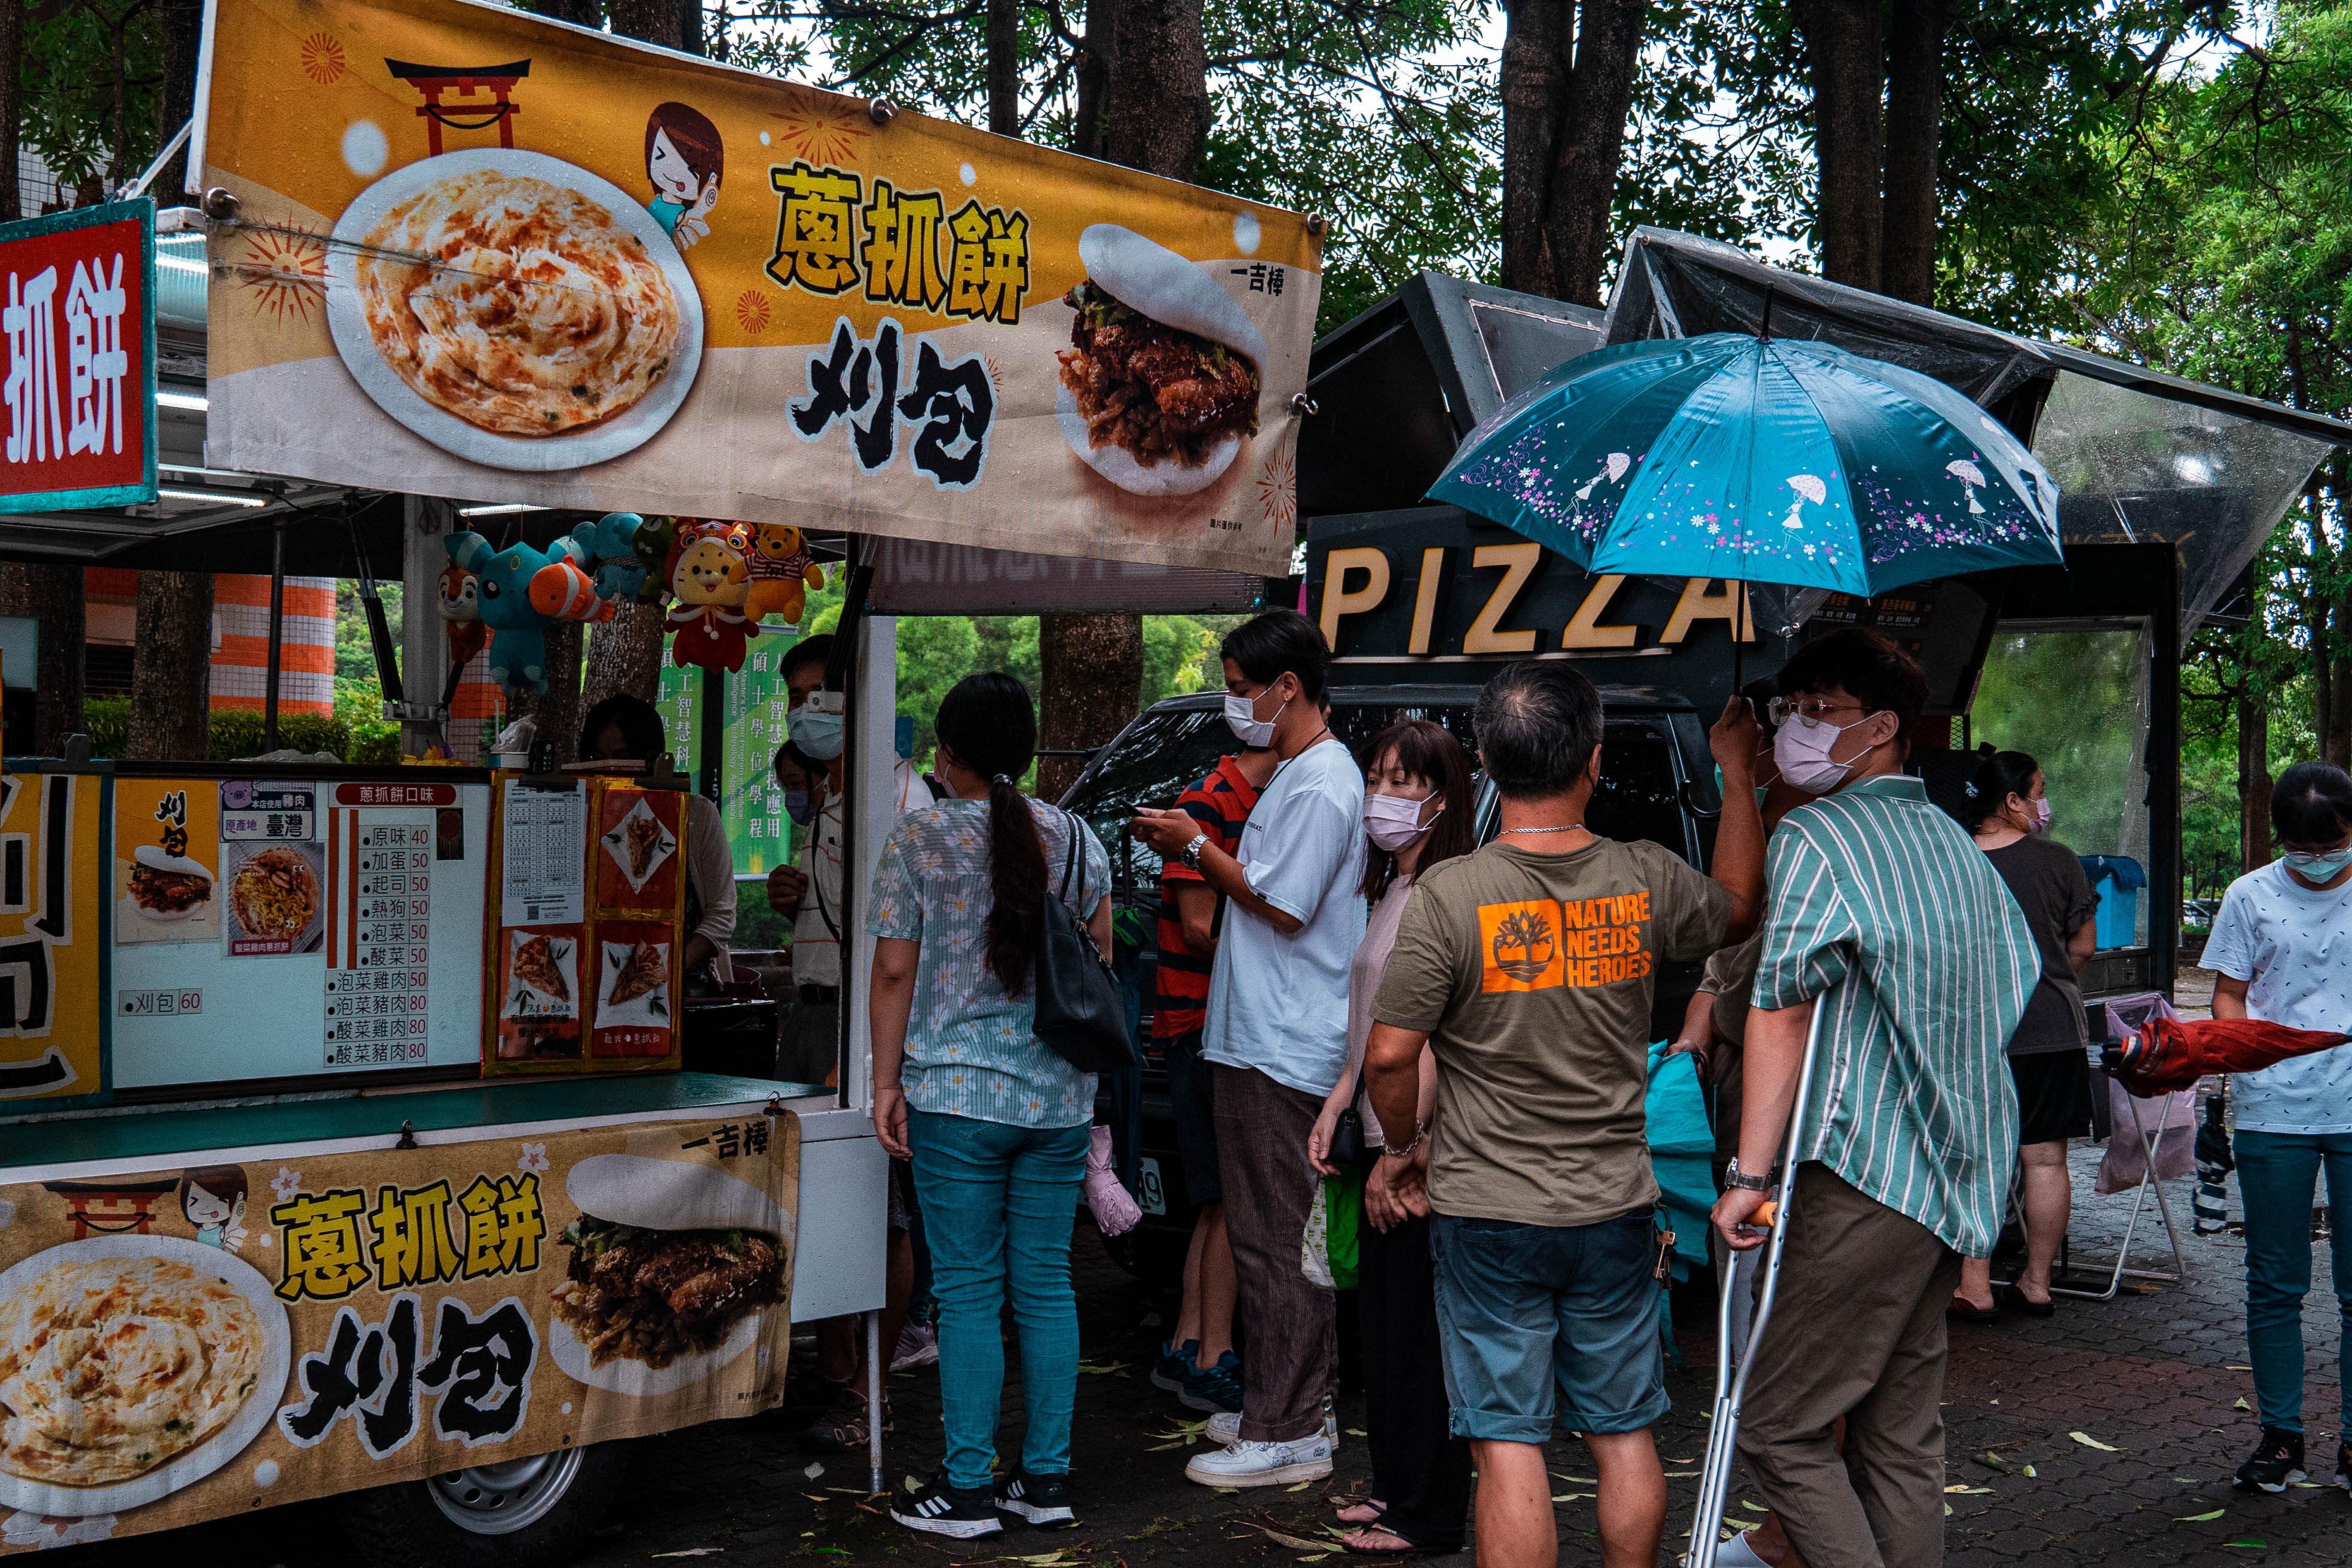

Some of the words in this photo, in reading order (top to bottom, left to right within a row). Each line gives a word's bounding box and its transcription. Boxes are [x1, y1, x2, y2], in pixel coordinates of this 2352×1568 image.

[769, 160, 1029, 323] 蔥抓餅
[1230, 262, 1284, 296] 一吉棒
[792, 323, 992, 484] 刈包
[1319, 541, 1756, 654] PIZZA
[749, 652, 767, 838] 碩士學位學程
[360, 786, 434, 803] 蔥抓餅口味
[155, 791, 188, 858] 刈包
[226, 819, 257, 831] 原產地
[267, 813, 302, 837] 臺灣
[372, 828, 406, 846] 原味
[412, 829, 428, 845] 40
[372, 852, 406, 871] 加蛋
[412, 853, 428, 869] 50
[372, 876, 406, 894] 起司
[411, 877, 428, 892] 50
[371, 900, 406, 918] 熱狗
[411, 901, 427, 915] 50
[1564, 891, 1651, 928] NATURE
[371, 924, 405, 942] 泡菜
[411, 924, 427, 939] 50
[1567, 924, 1640, 958] NEEDS
[370, 948, 405, 966] 酸菜
[411, 948, 427, 963] 50
[1567, 951, 1651, 987] HEROES
[337, 972, 406, 991] 泡菜雞肉
[410, 972, 426, 987] 50
[136, 993, 174, 1013] 刈包
[181, 993, 200, 1010] 60
[337, 996, 406, 1016] 泡菜豬肉
[410, 996, 426, 1011] 80
[336, 1019, 406, 1040] 酸菜雞肉
[409, 1019, 425, 1035] 80
[336, 1044, 405, 1064] 酸菜豬肉
[409, 1043, 425, 1059] 80
[681, 1122, 768, 1159] 一吉棒
[272, 1172, 545, 1303] 蔥抓餅
[285, 1301, 533, 1452] 刈包
